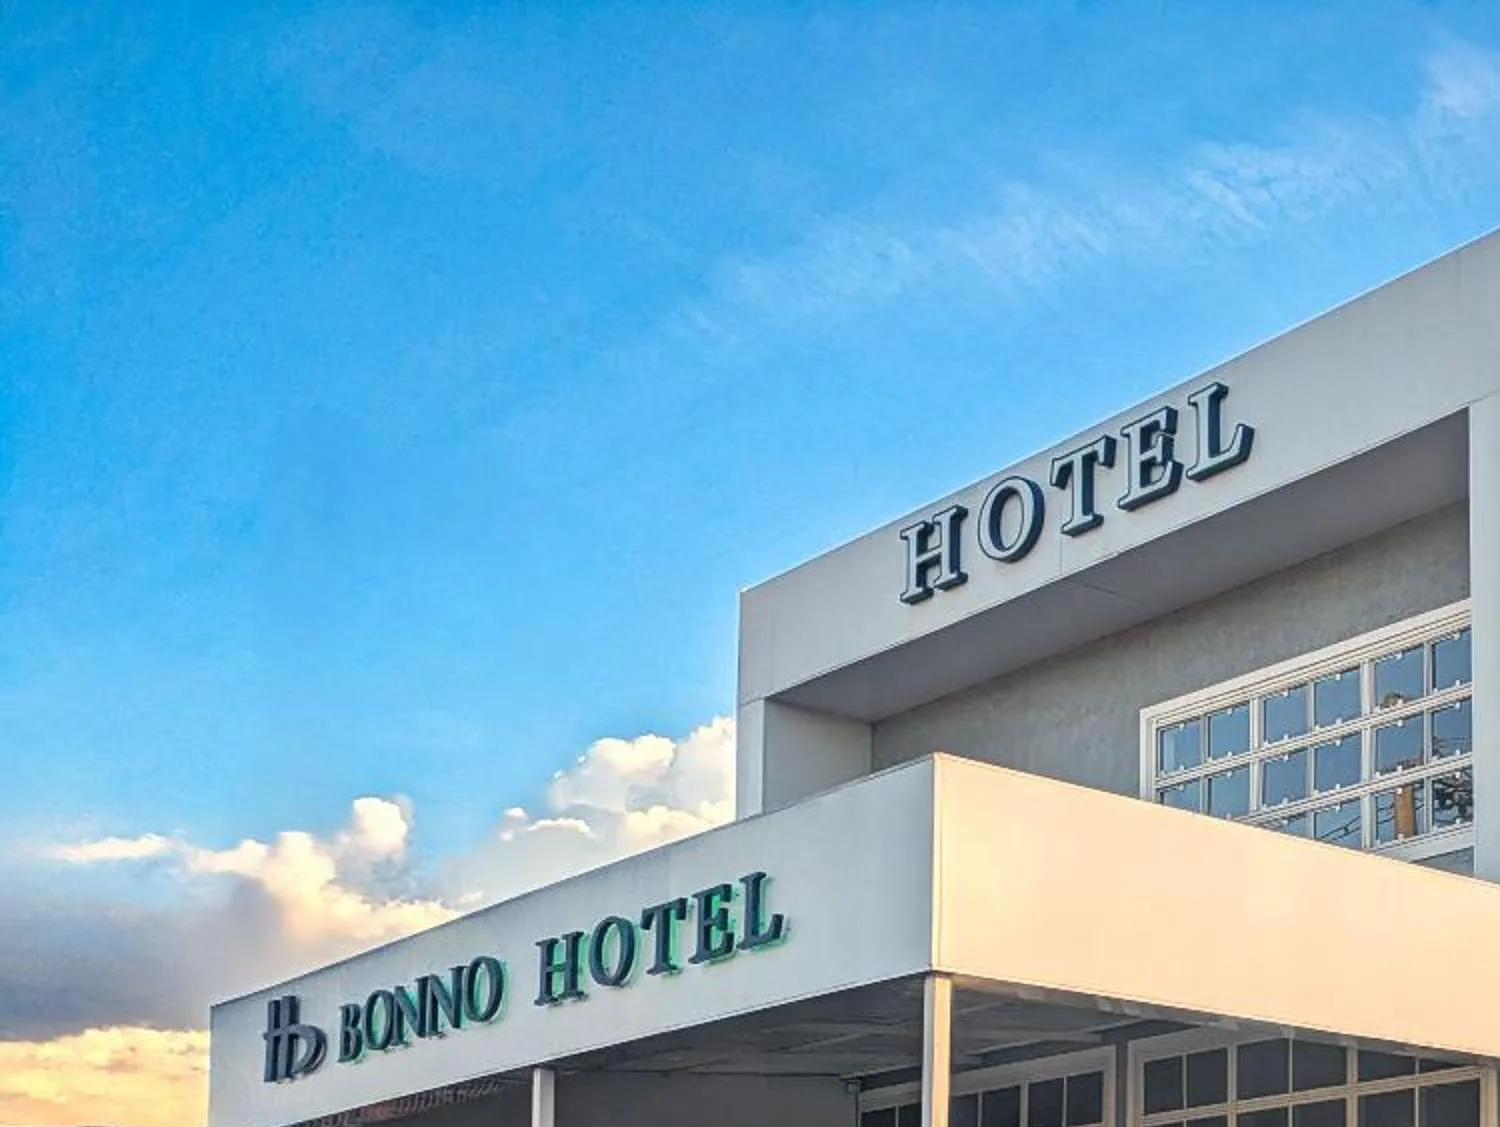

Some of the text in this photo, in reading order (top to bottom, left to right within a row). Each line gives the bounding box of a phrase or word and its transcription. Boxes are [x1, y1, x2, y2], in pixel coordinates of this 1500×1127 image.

[899, 381, 1255, 604] HOTEL
[337, 871, 785, 1063] BONNO HOTEL
